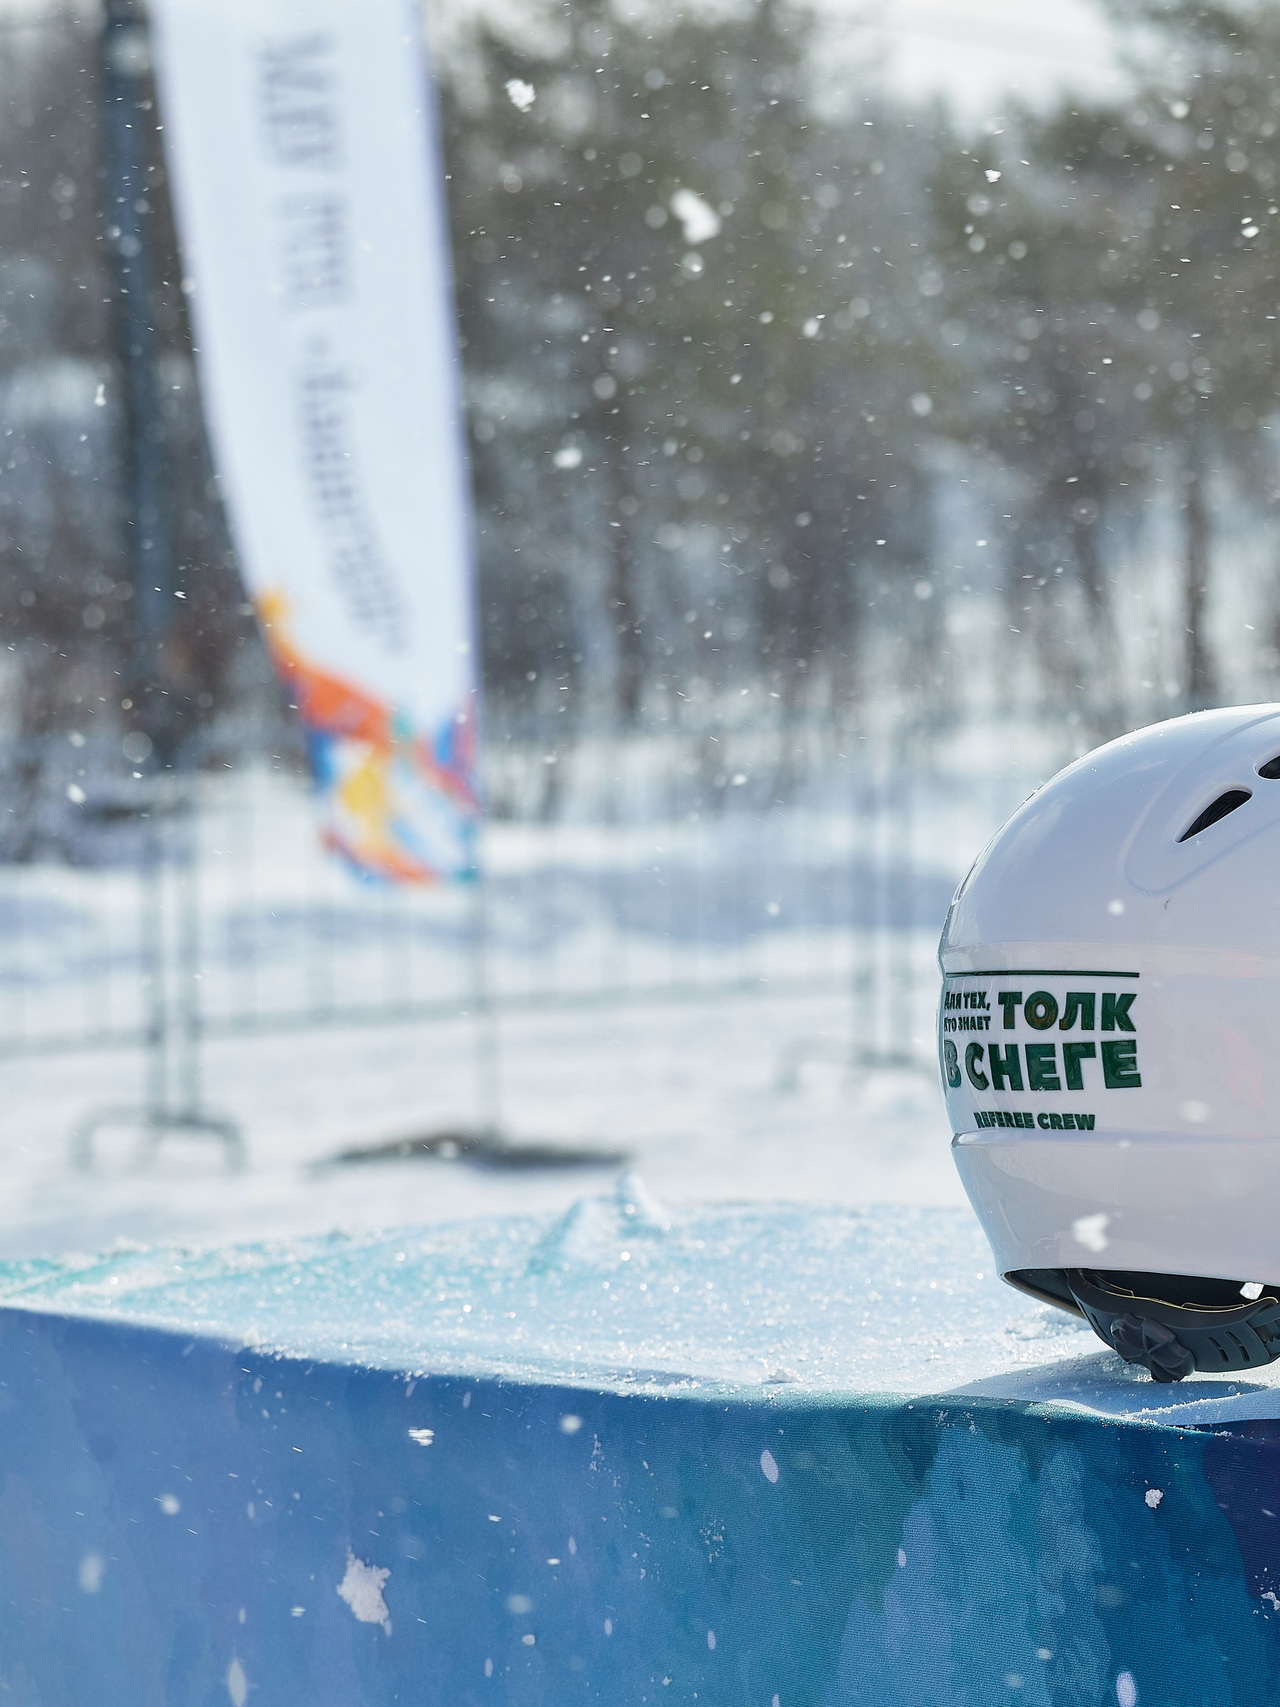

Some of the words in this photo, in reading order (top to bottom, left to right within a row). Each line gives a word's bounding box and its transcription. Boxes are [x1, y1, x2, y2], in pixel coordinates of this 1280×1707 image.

[944, 991, 962, 1010] ДЛЯ
[963, 991, 991, 1011] ТЕХ,
[998, 991, 1137, 1031] ТОЛК
[958, 1016, 991, 1031] ЗНАЕТ
[944, 1040, 962, 1088] В
[965, 1040, 1142, 1091] СНЕГЕ
[973, 1111, 1036, 1129] REFEREE
[1037, 1113, 1096, 1131] CREW
